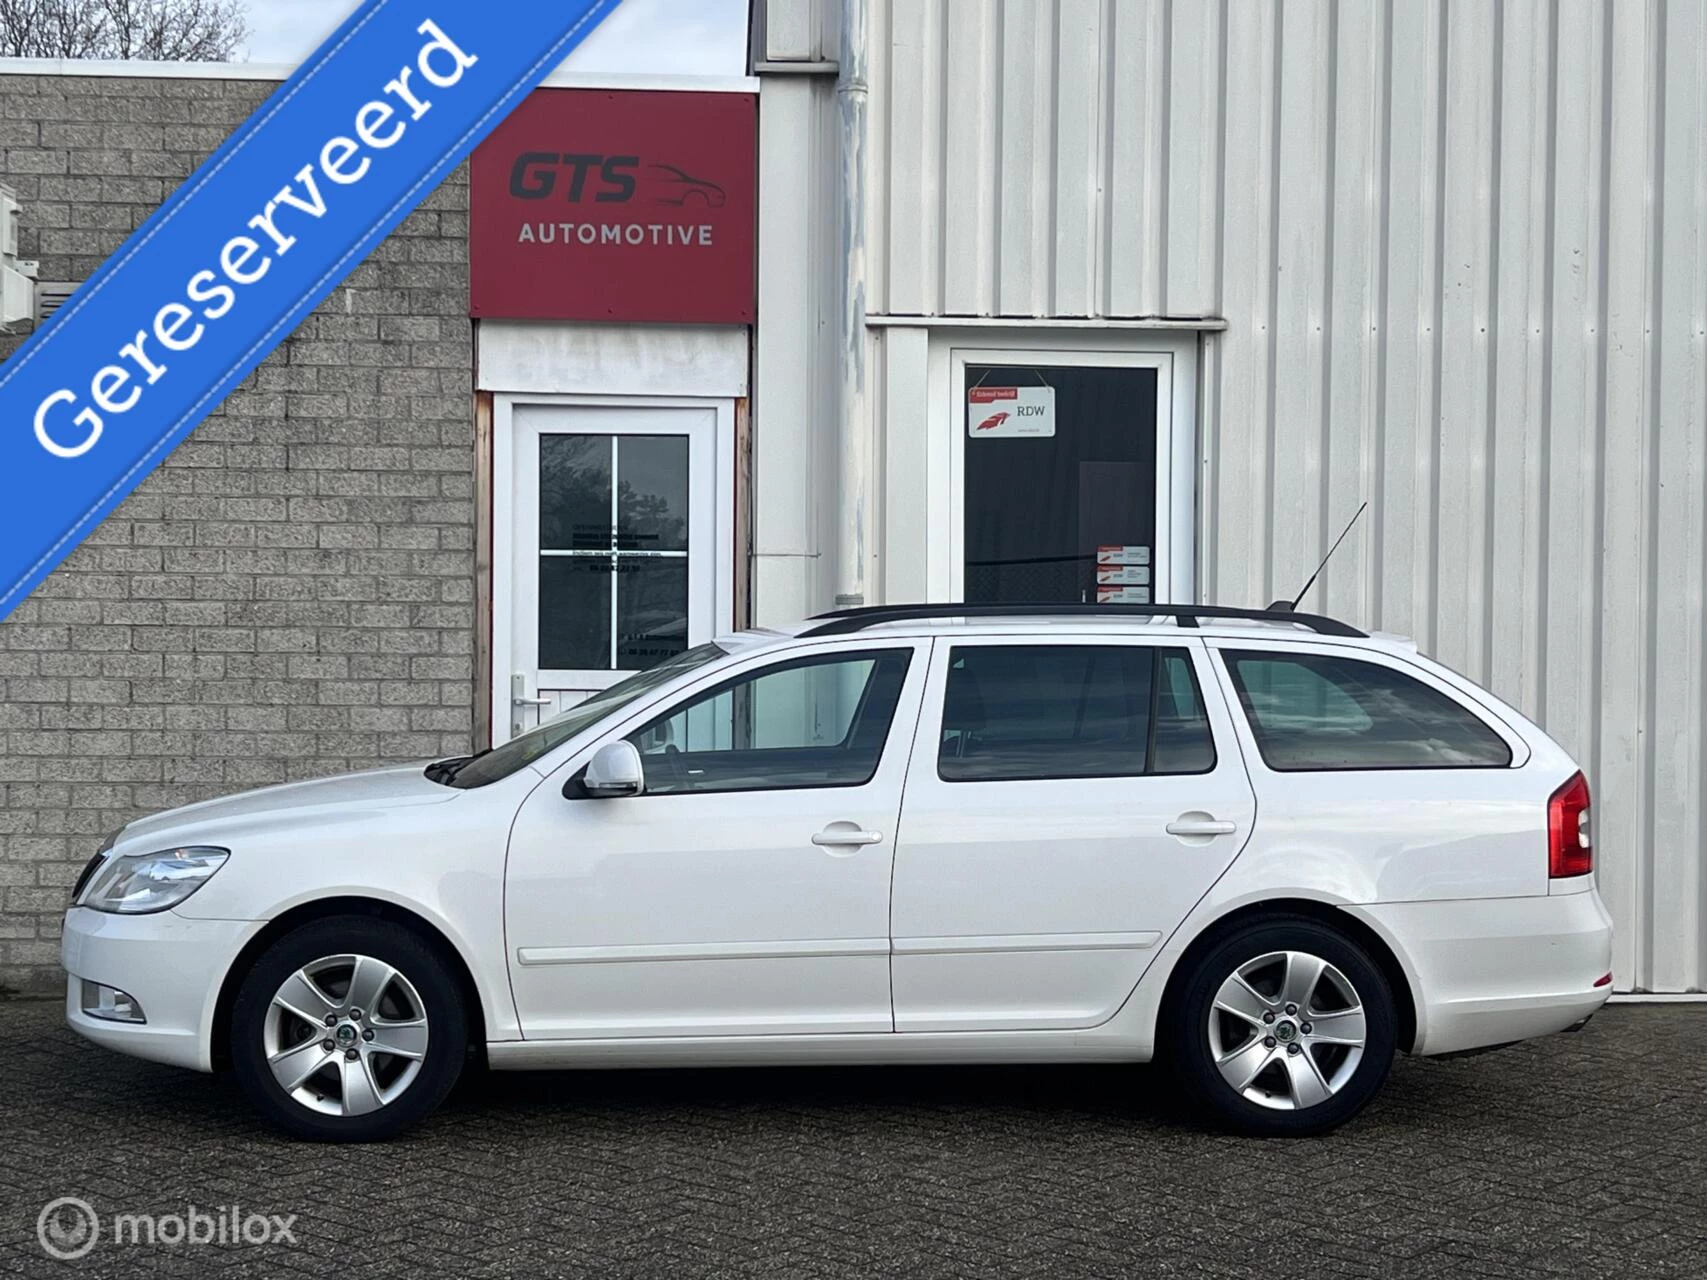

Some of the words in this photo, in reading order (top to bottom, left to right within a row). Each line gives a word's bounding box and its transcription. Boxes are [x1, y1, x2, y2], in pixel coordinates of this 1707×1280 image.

[509, 151, 640, 204] GTS
[518, 223, 713, 246] AUTOMOTIVE
[1016, 405, 1046, 417] RDW
